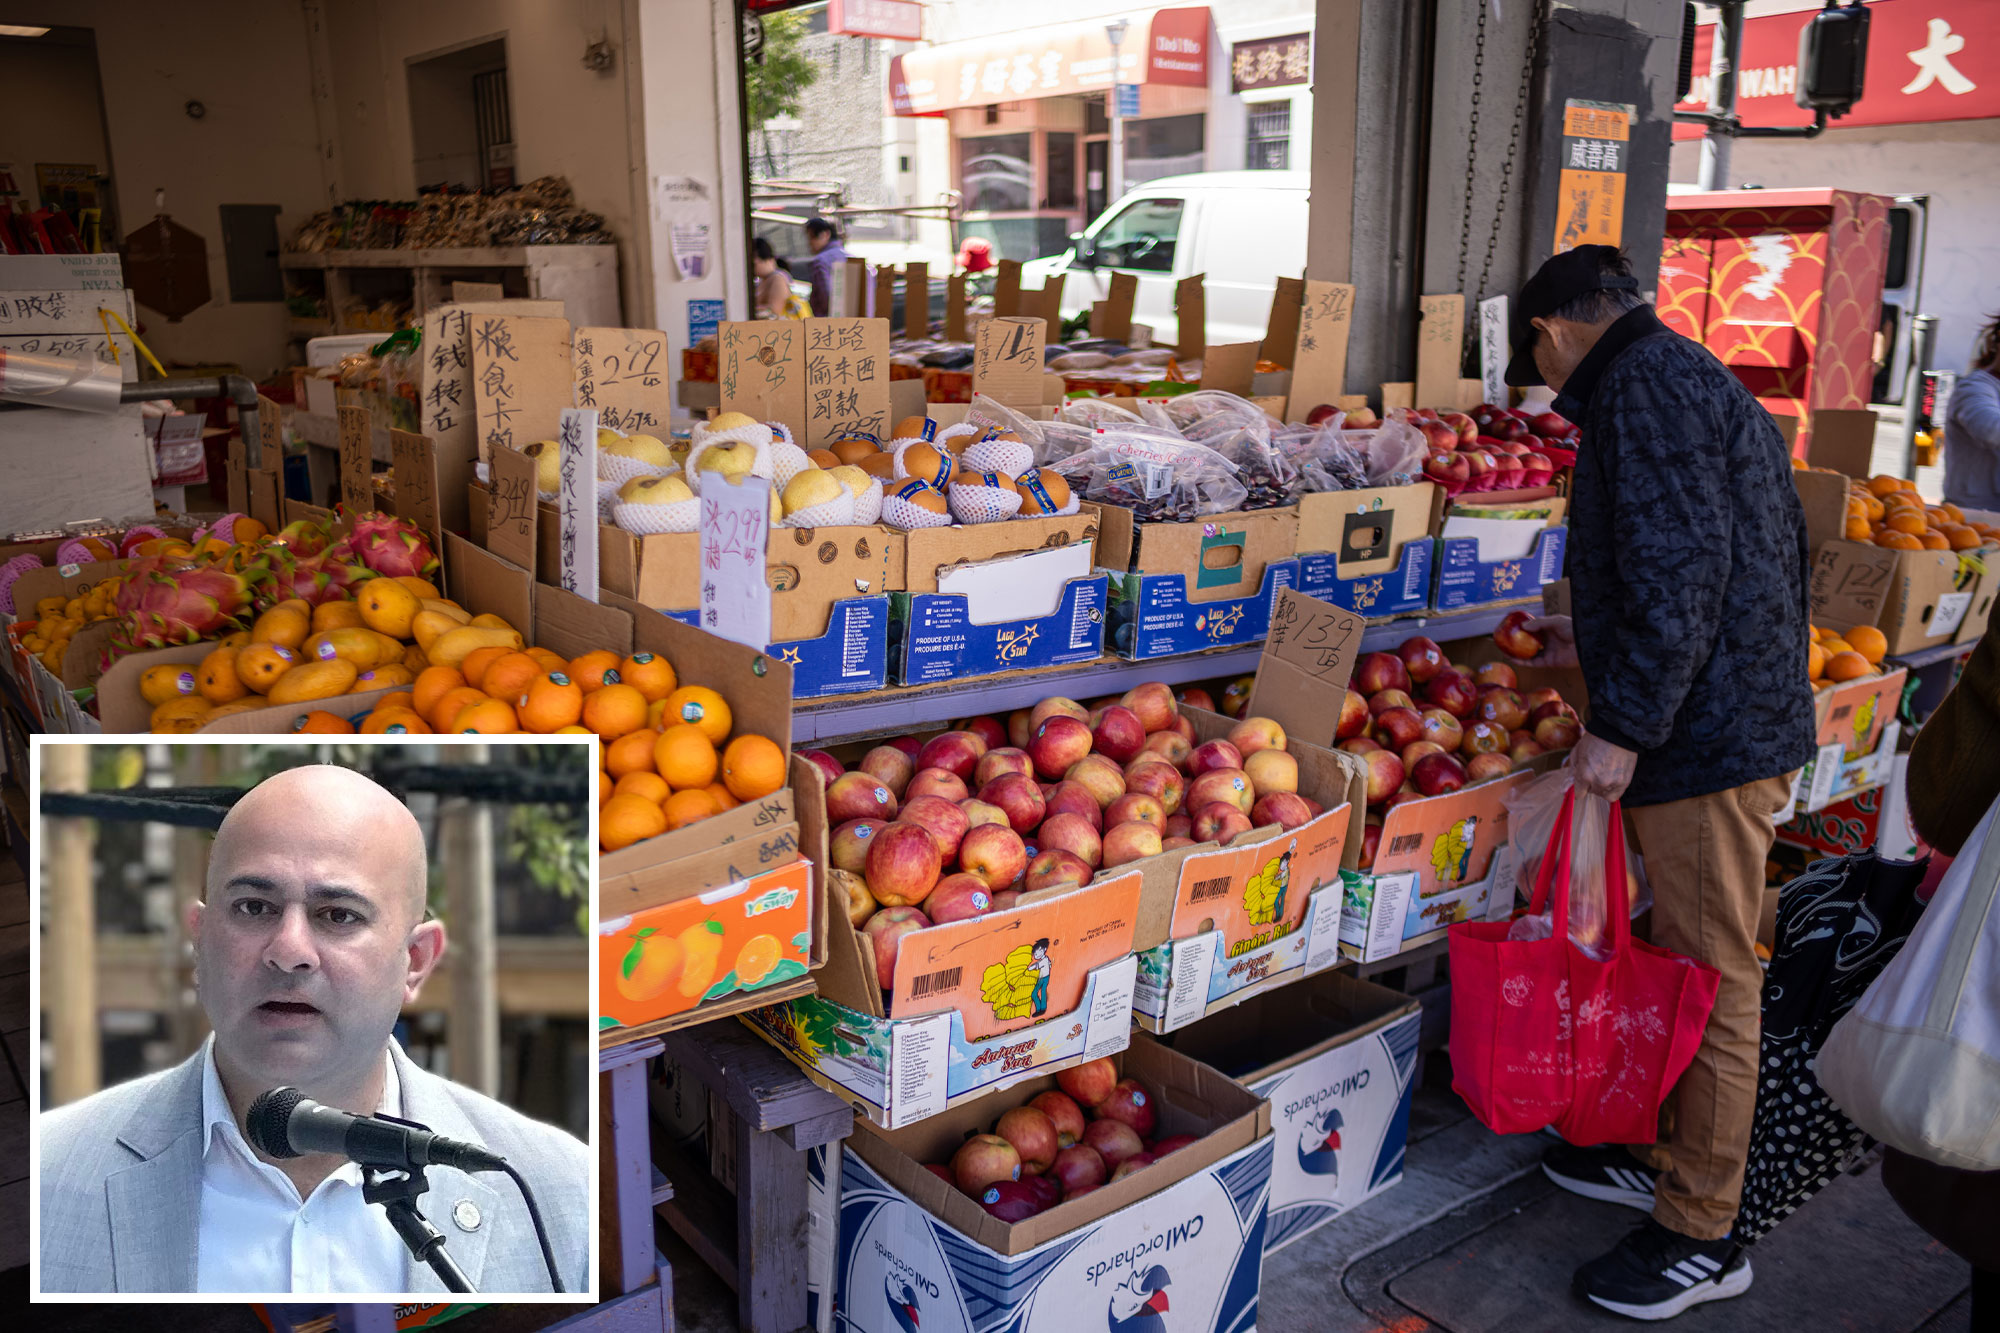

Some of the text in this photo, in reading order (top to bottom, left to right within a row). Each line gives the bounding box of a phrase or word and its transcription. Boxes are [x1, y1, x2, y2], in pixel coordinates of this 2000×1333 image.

[1900, 18, 1977, 95] 大
[1739, 65, 1797, 98] WAH
[1361, 550, 1372, 559] HP
[915, 645, 941, 653] PRODUIRE
[916, 636, 942, 644] PRODUCE
[745, 889, 798, 917] Yosway
[971, 1038, 1037, 1069] Autumn
[1001, 1054, 1032, 1073] Sun
